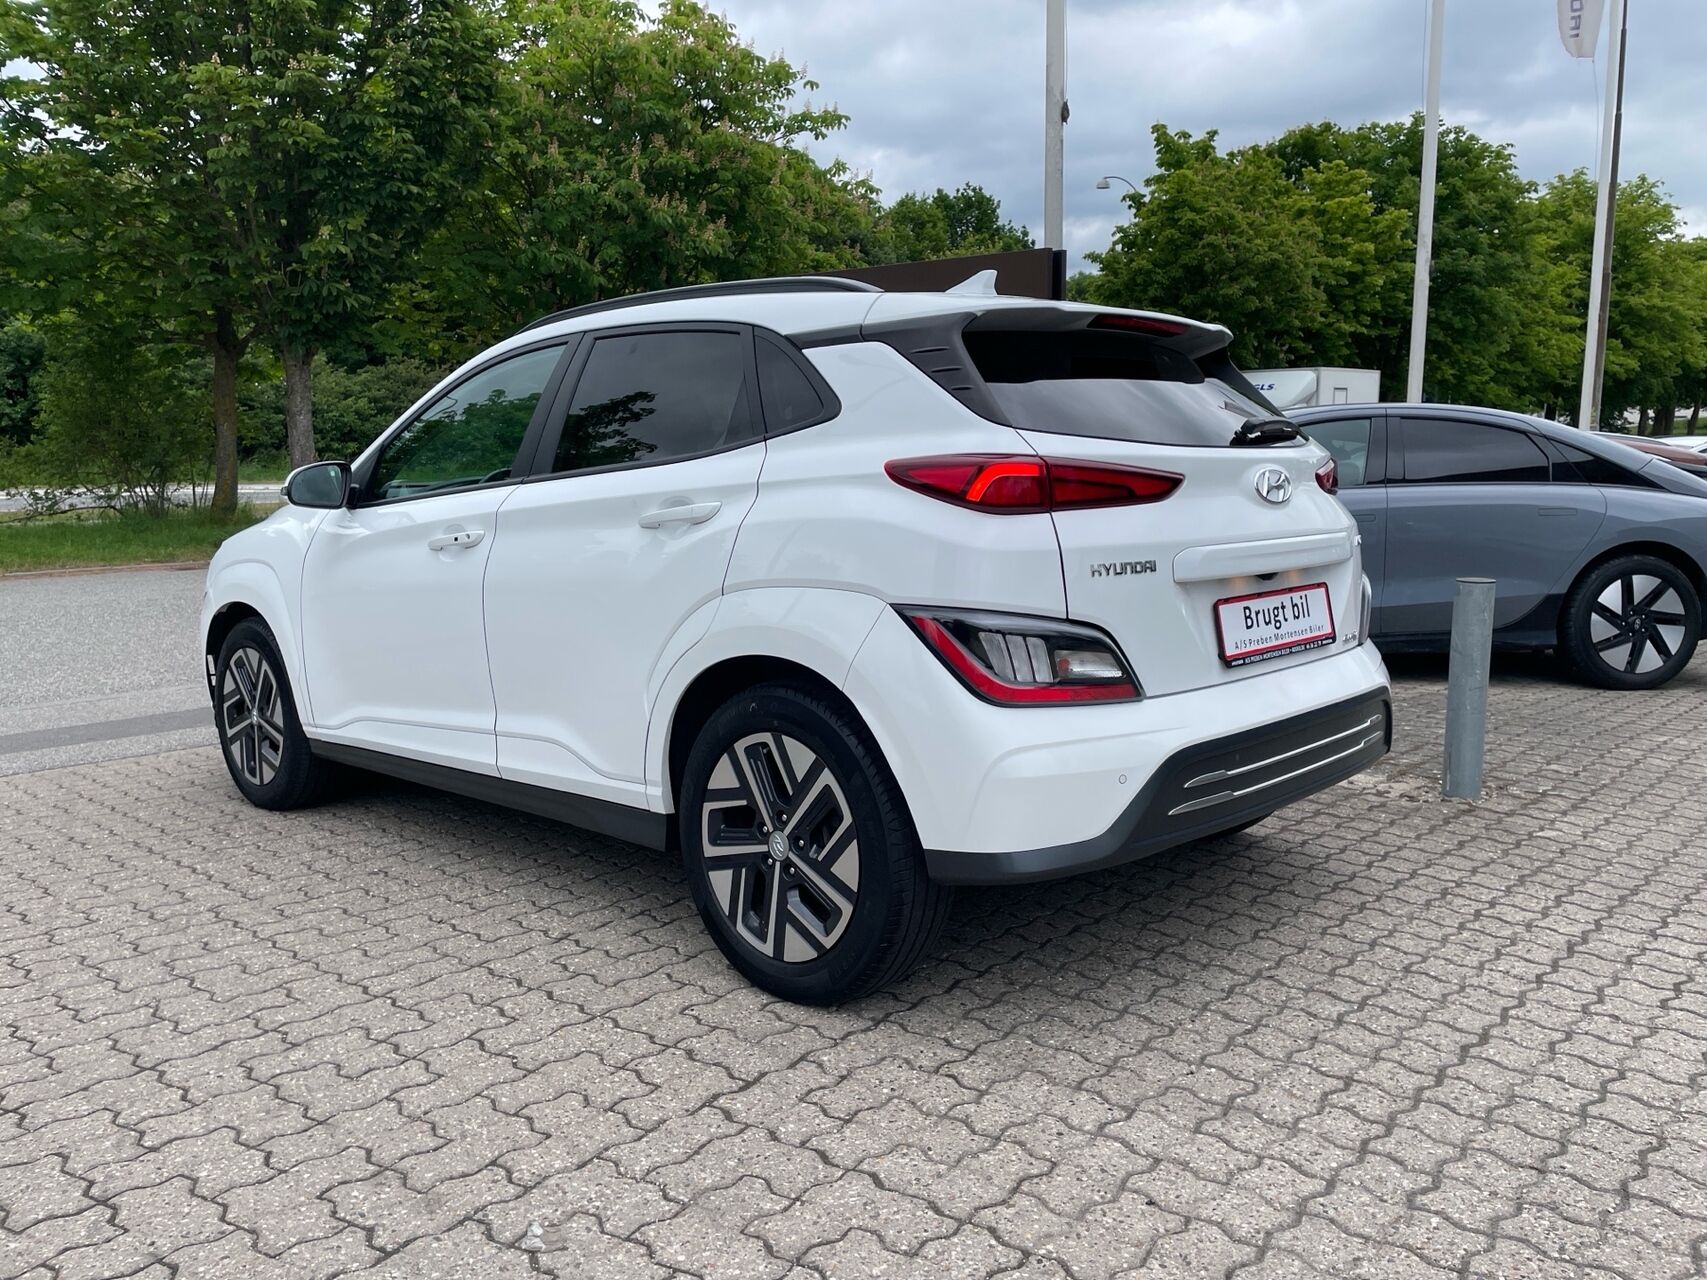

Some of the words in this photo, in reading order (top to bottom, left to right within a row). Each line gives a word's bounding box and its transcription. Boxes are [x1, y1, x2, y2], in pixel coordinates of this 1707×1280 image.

[1090, 560, 1157, 578] HYUNDAI
[1243, 601, 1288, 630] Brugt
[1290, 594, 1311, 620] bil
[1234, 639, 1248, 650] A/S
[1249, 635, 1273, 647] Preben
[1273, 627, 1308, 642] Mortensen
[1309, 624, 1324, 635] Biler
